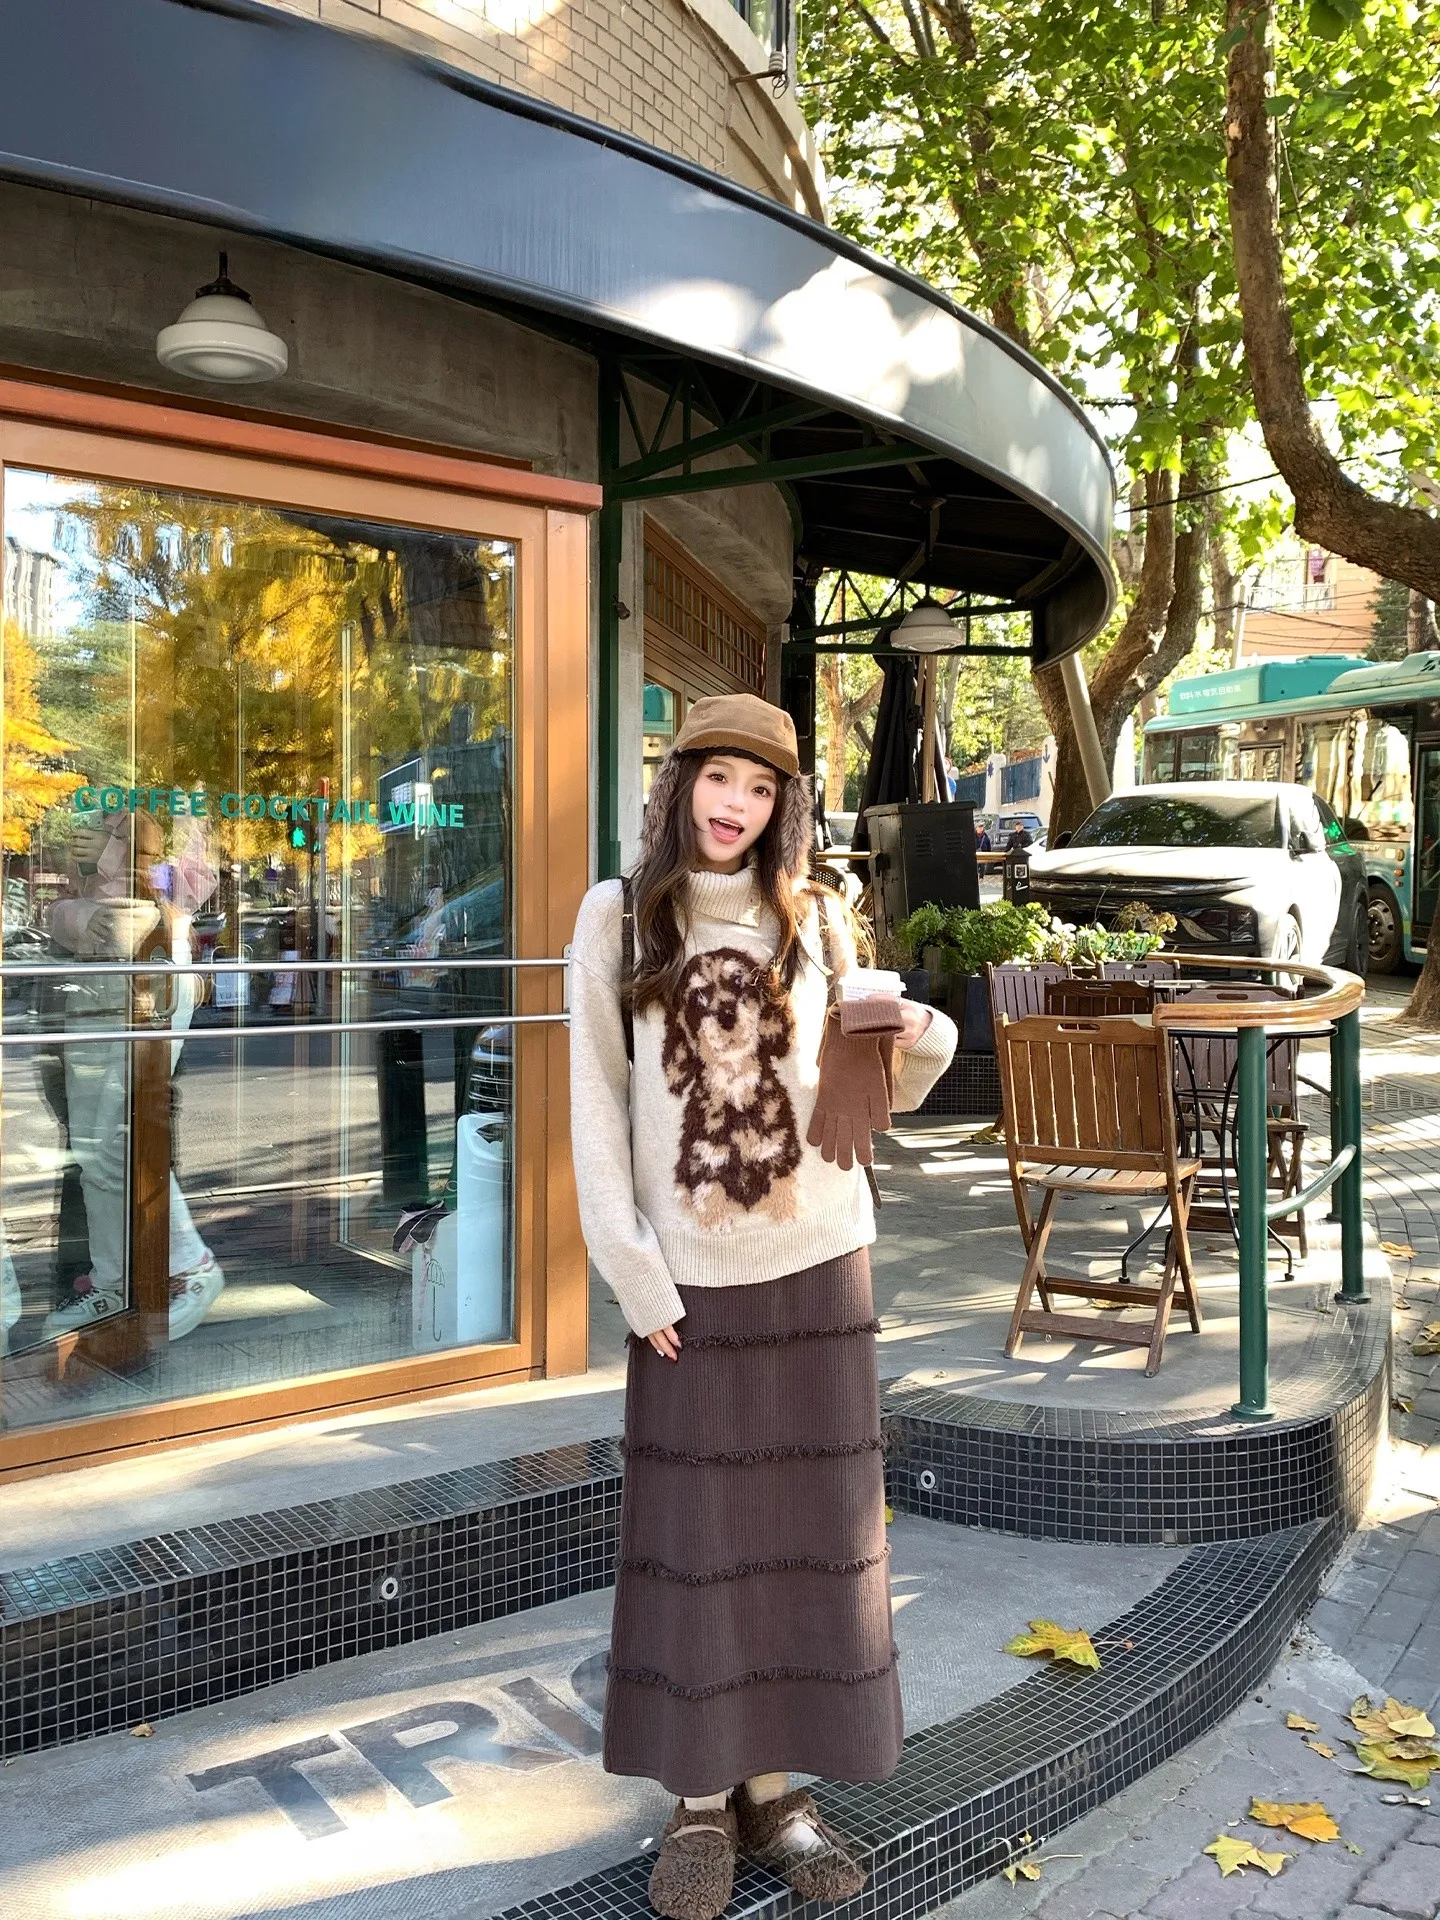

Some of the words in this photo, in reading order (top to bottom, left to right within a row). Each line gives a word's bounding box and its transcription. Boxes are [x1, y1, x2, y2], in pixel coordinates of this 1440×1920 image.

[75, 785, 207, 817] COFFEE
[220, 793, 379, 824] COCKTAIL
[388, 801, 464, 828] WINE
[185, 1648, 612, 1841] TRI
